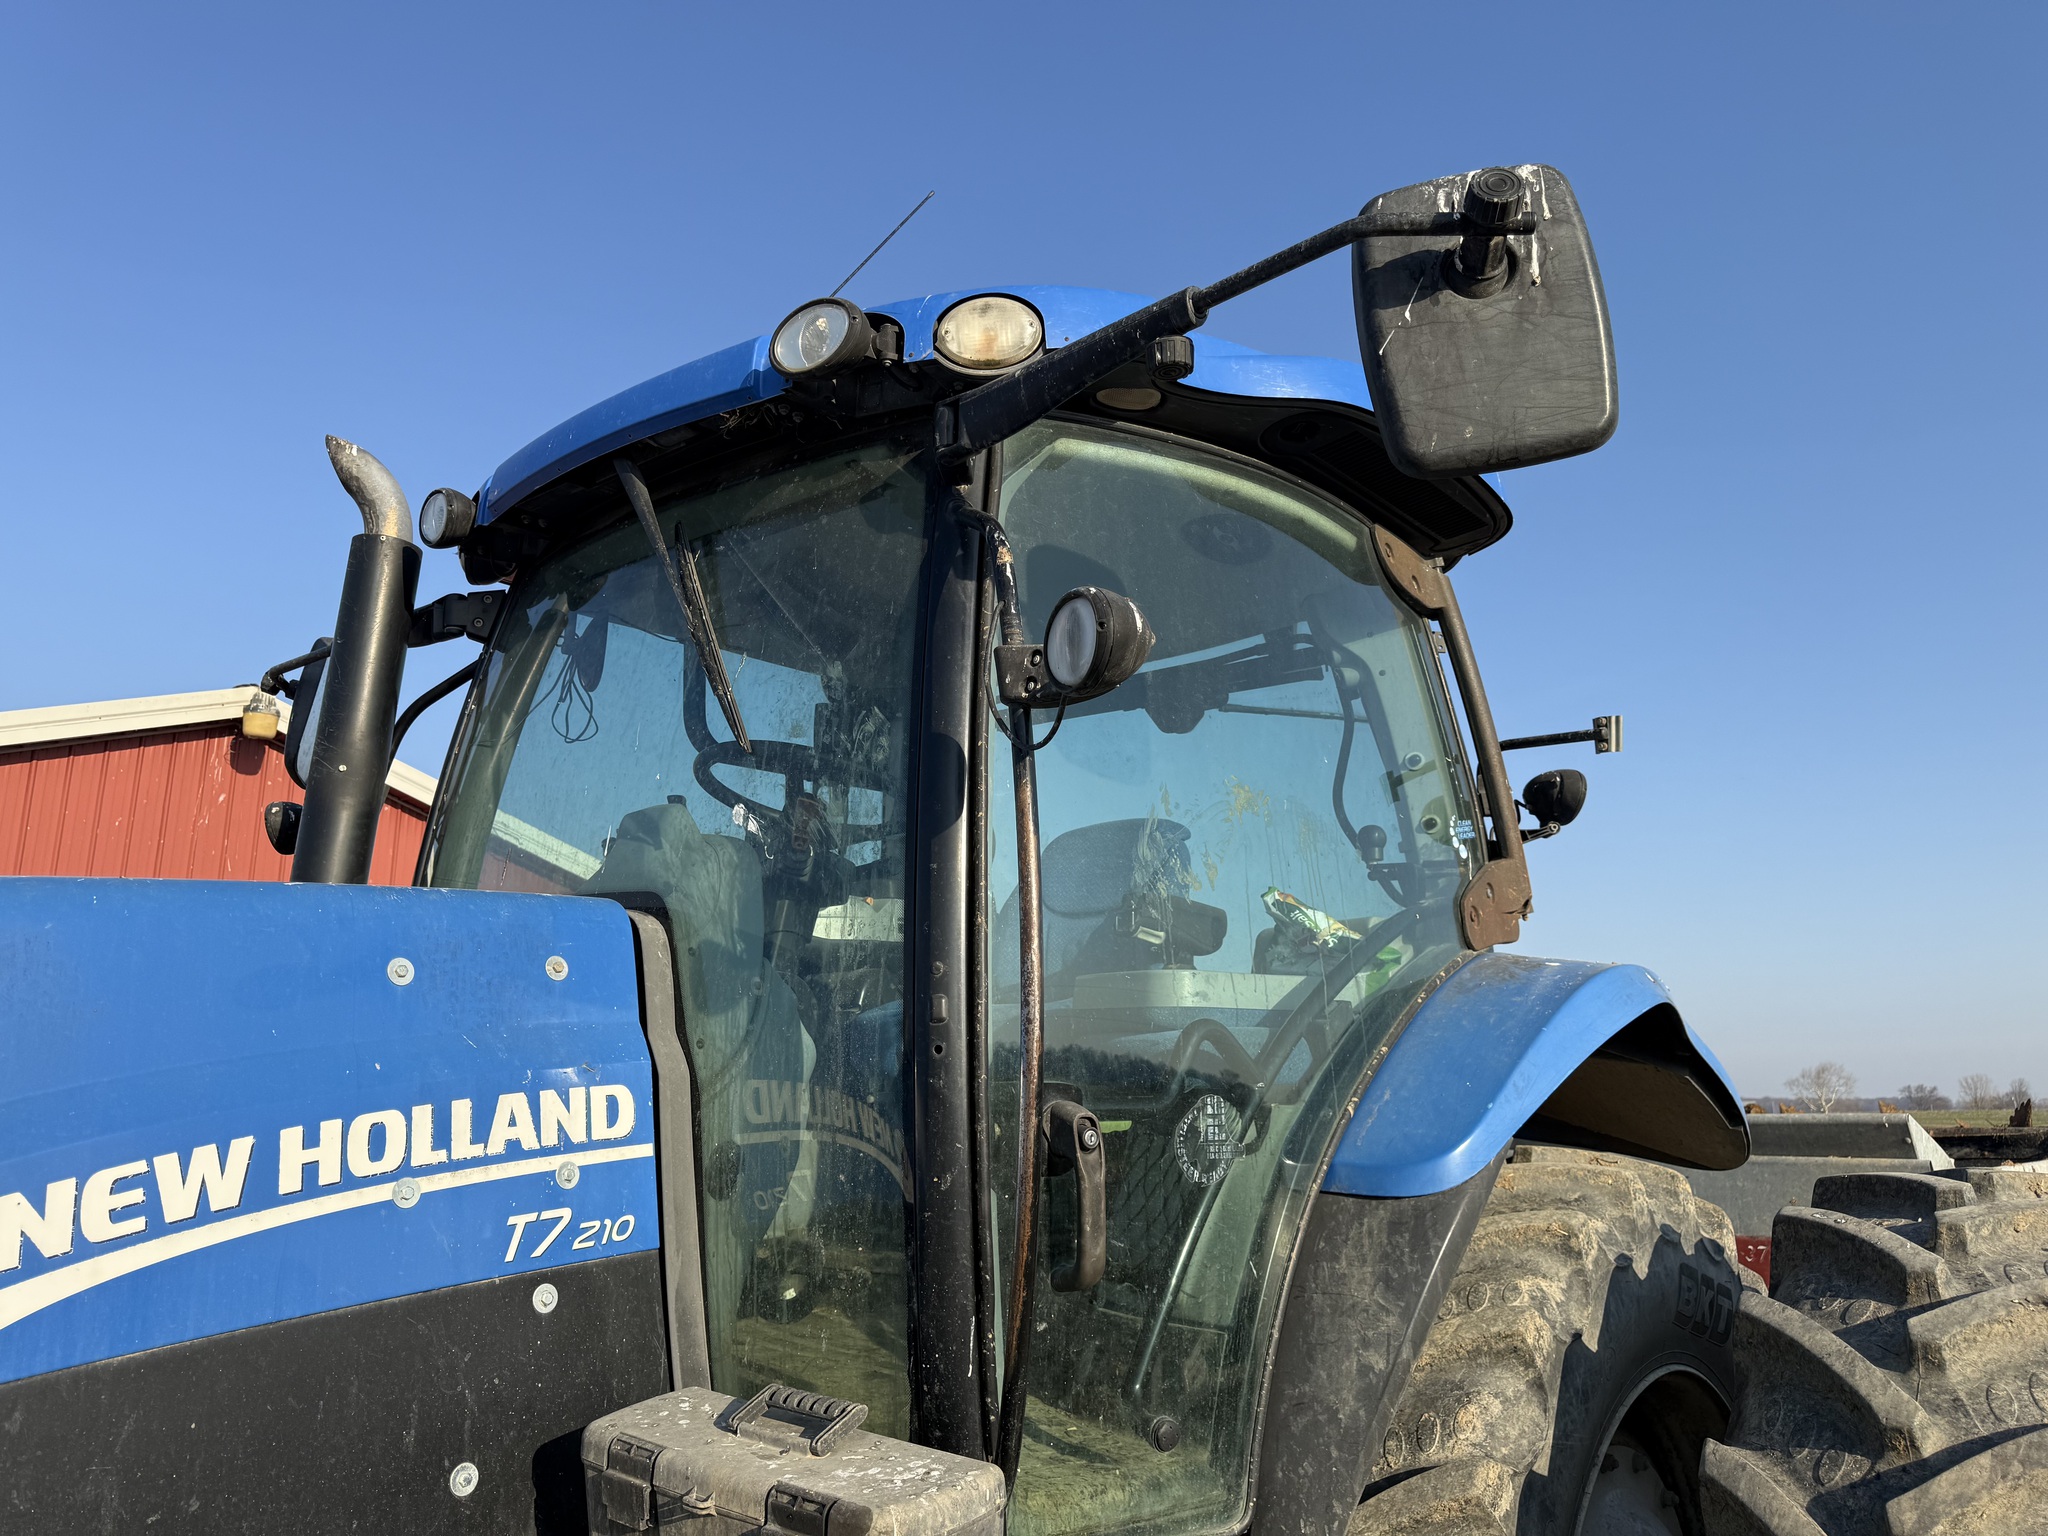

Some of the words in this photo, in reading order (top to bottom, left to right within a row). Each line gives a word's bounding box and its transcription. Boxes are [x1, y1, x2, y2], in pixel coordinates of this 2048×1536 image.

[0, 1136, 256, 1273] NEW
[278, 1084, 637, 1197] HOLLAND
[504, 1207, 572, 1263] T7
[571, 1214, 635, 1251] 210
[1676, 1272, 1733, 1336] BKT
